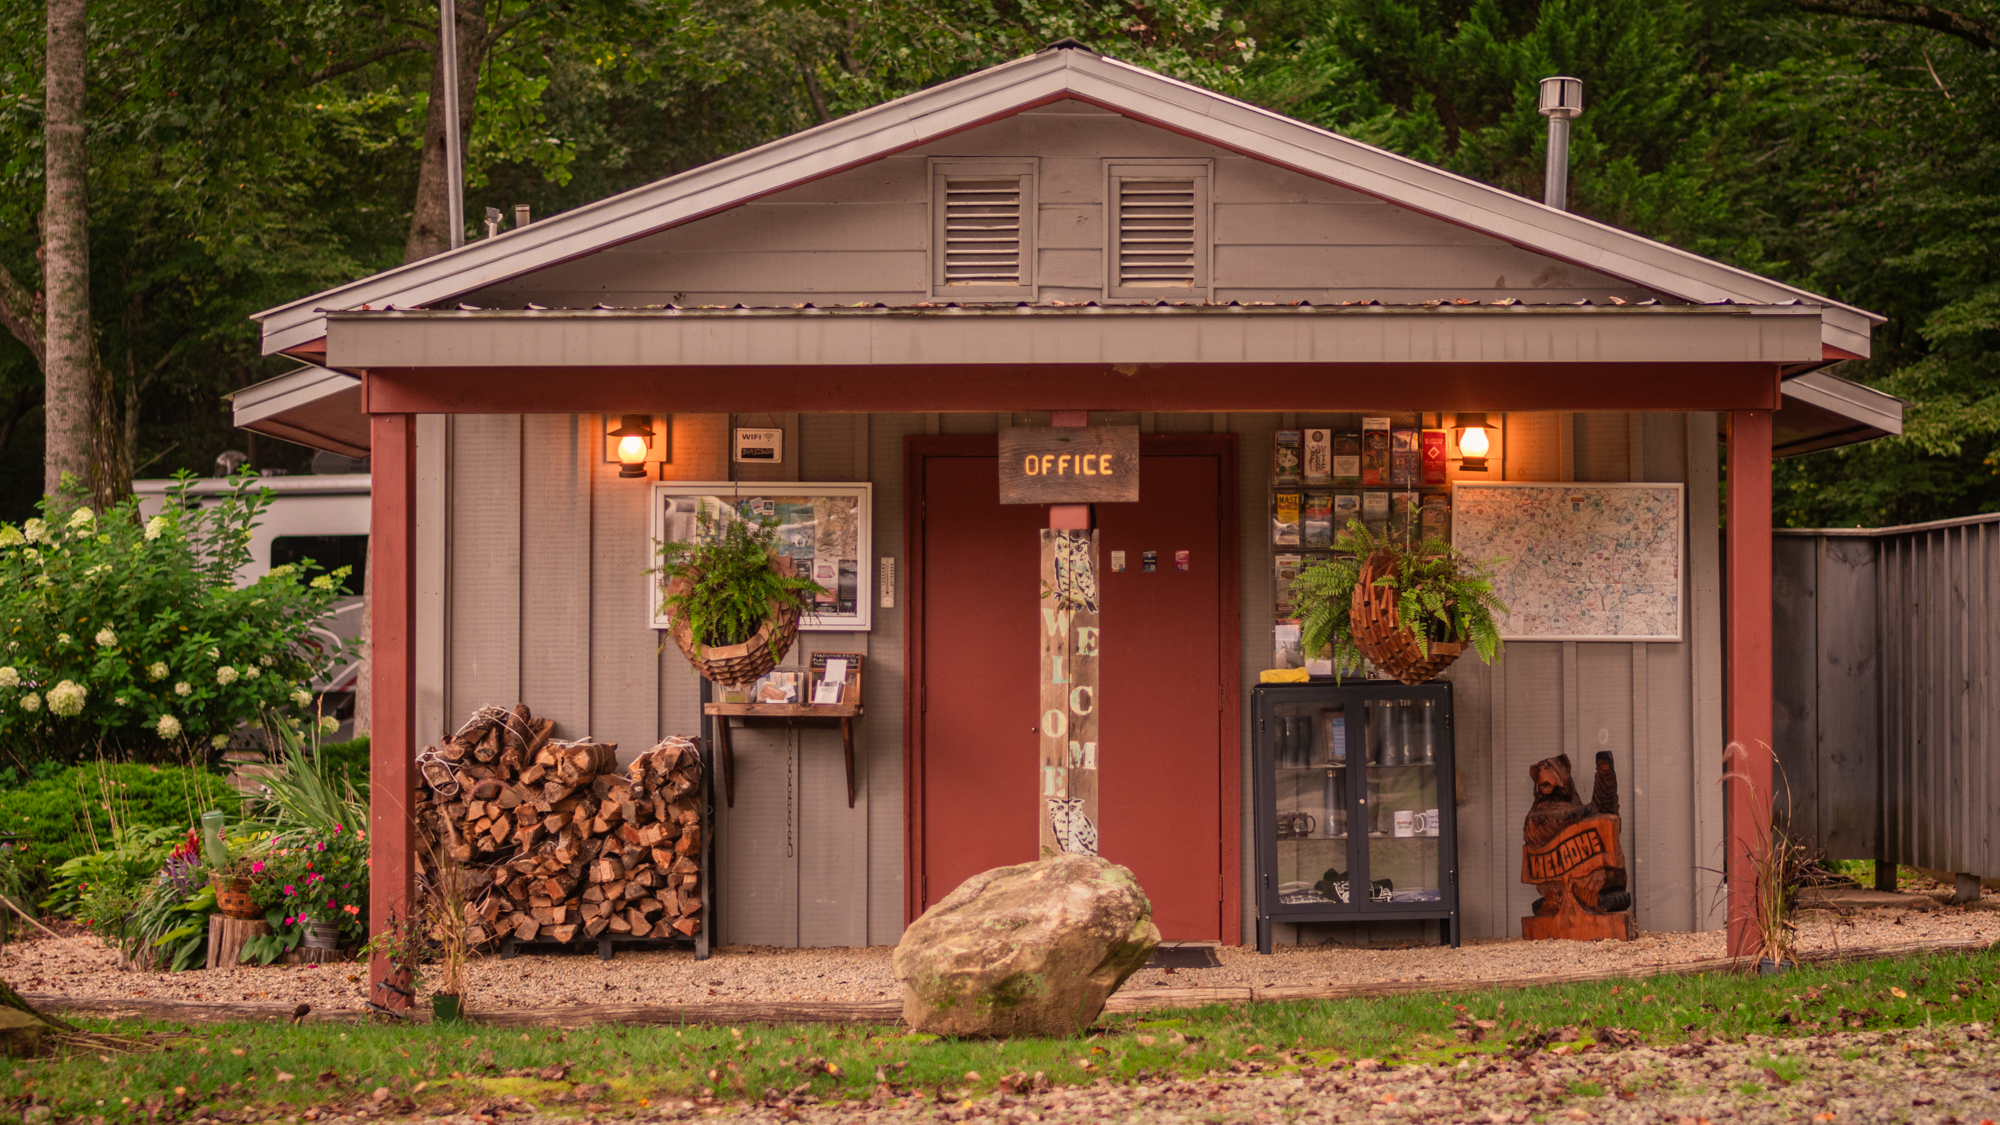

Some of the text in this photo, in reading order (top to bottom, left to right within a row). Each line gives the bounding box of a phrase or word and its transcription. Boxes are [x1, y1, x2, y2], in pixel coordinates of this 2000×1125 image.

[1025, 454, 1113, 476] OFFICE
[1279, 495, 1298, 504] MAST
[1041, 607, 1099, 797] WELCOME
[1529, 830, 1602, 879] WELCOME
